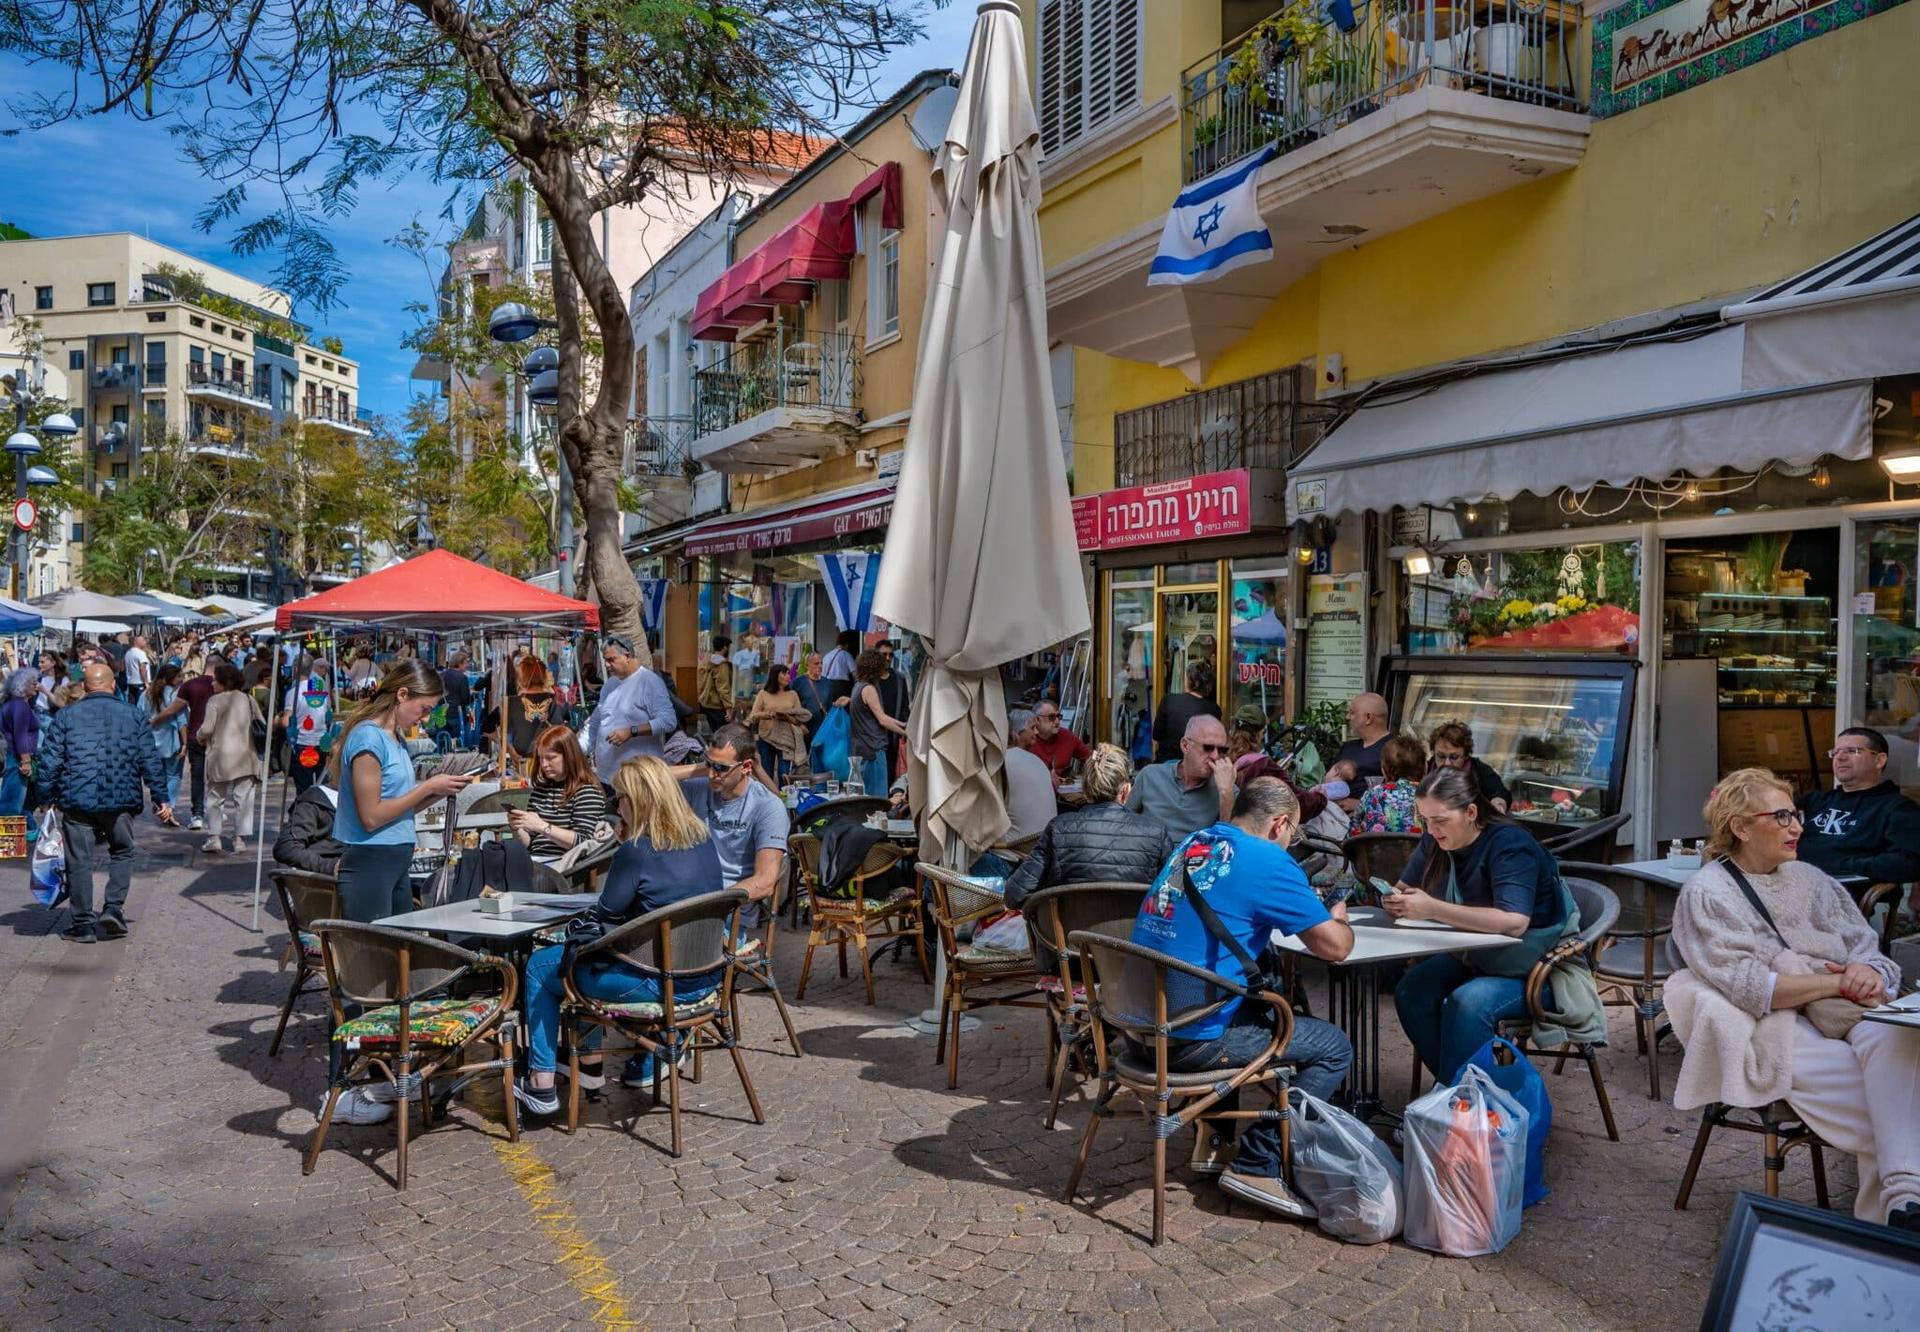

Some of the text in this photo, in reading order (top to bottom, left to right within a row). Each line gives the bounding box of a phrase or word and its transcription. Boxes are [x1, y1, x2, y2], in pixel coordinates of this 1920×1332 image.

[1107, 486, 1238, 533] חייט מתפרה
[1107, 528, 1181, 544] PROFESSIONAL TAILOR
[1312, 550, 1328, 573] 13
[1239, 663, 1281, 686] חייט
